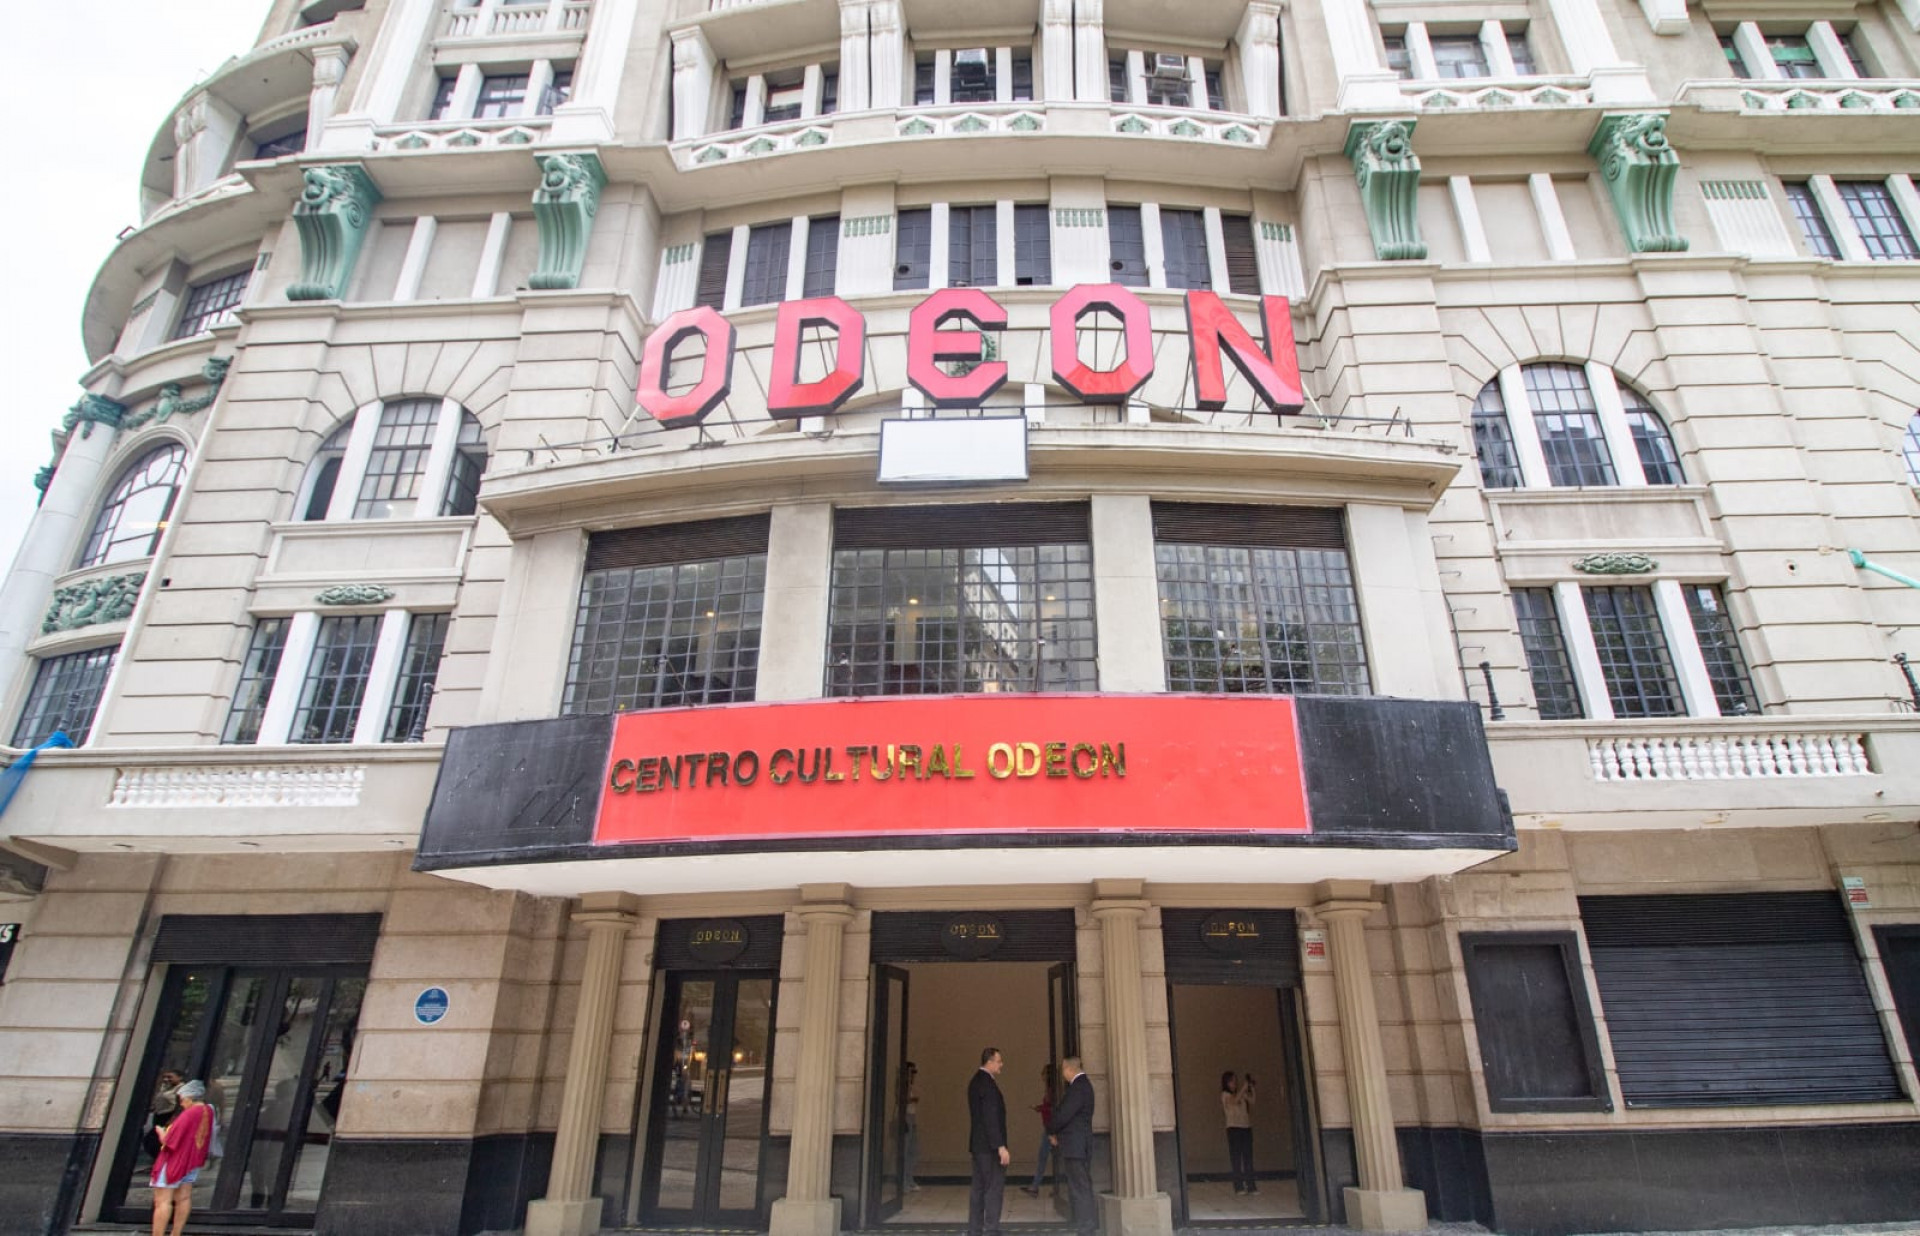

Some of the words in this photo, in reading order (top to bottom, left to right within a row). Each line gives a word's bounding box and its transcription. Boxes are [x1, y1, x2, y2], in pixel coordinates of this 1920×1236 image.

[635, 283, 1304, 428] ODEON
[611, 750, 759, 793] CENTRO
[769, 743, 975, 785] CULTURAL
[988, 742, 1126, 780] ODEON
[695, 930, 740, 942] ODEON
